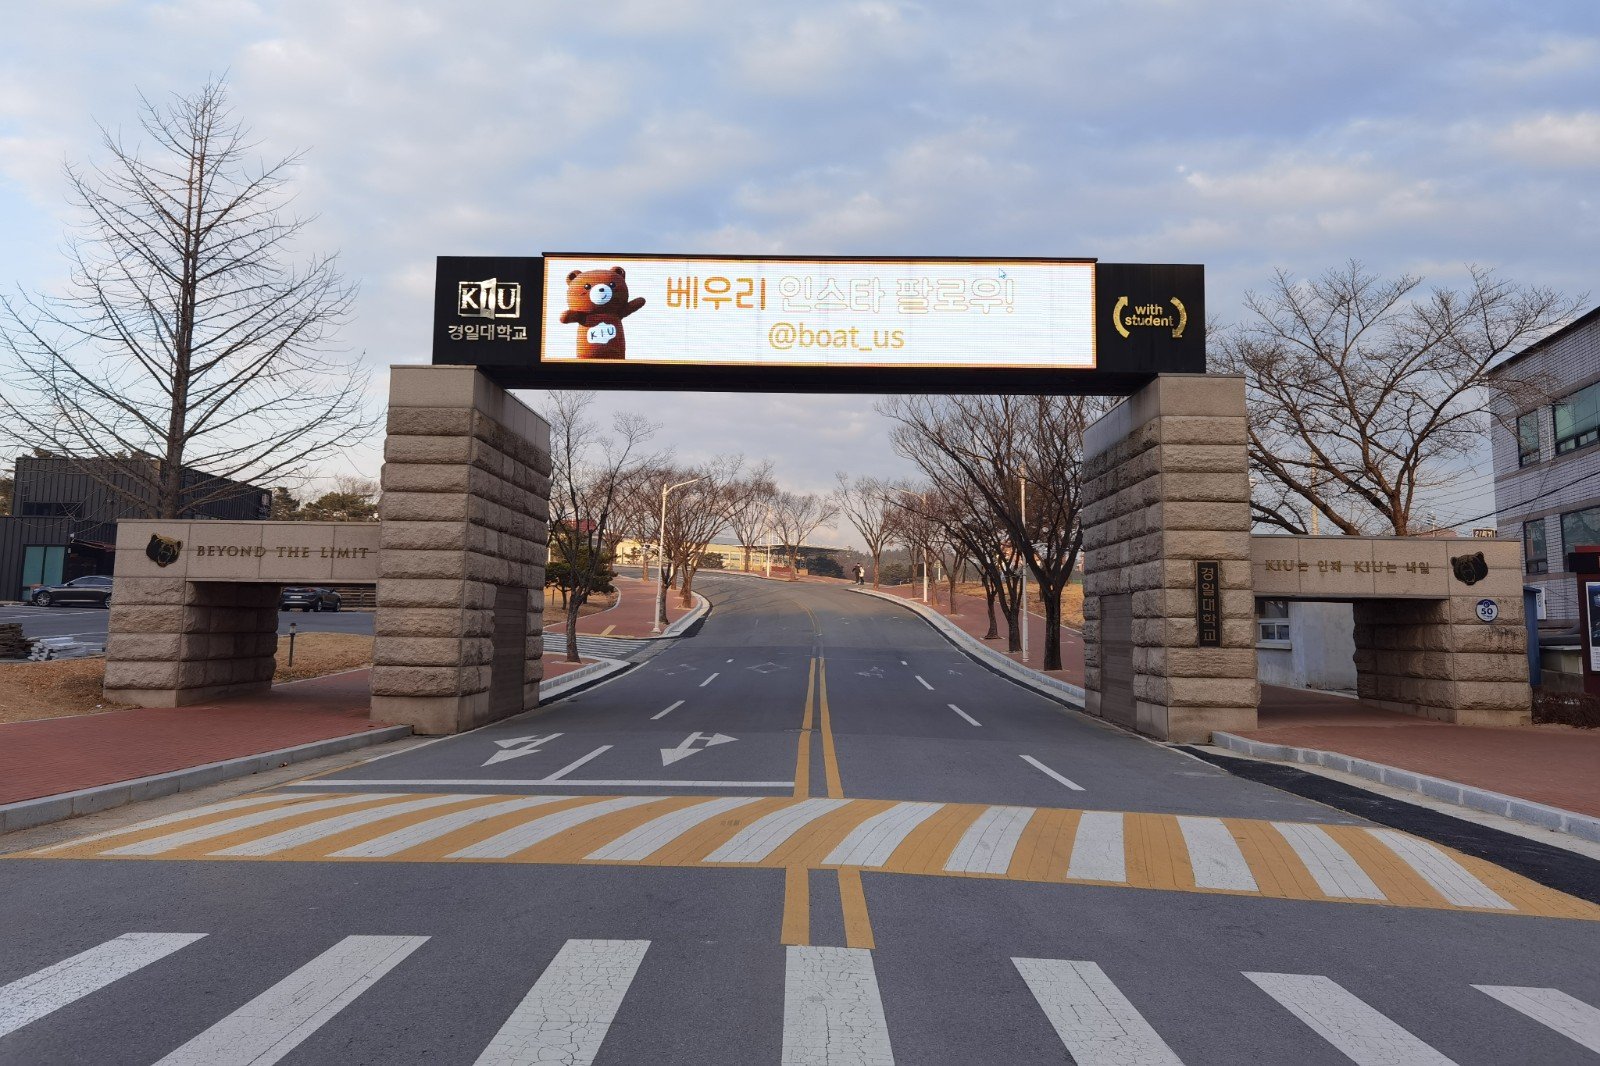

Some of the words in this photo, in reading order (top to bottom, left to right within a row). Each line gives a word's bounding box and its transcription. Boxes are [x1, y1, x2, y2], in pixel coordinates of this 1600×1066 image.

[460, 286, 518, 312] KIU
[666, 276, 766, 310] 베우리
[778, 276, 886, 313] 인스타
[896, 278, 1014, 314] 팔로우!
[1135, 304, 1163, 315] with
[1125, 315, 1174, 326] student
[448, 324, 528, 341] 경일대학교
[590, 327, 615, 340] KIU
[768, 321, 905, 351] @boat_us
[196, 545, 266, 558] BEYOND
[276, 546, 310, 558] THE
[320, 547, 369, 559] LIMIT
[1265, 559, 1309, 572] KIU는
[1317, 560, 1342, 573] 인재
[1353, 560, 1398, 574] KIU는
[1405, 561, 1430, 575] 내일
[1201, 567, 1217, 641] 경일대학교
